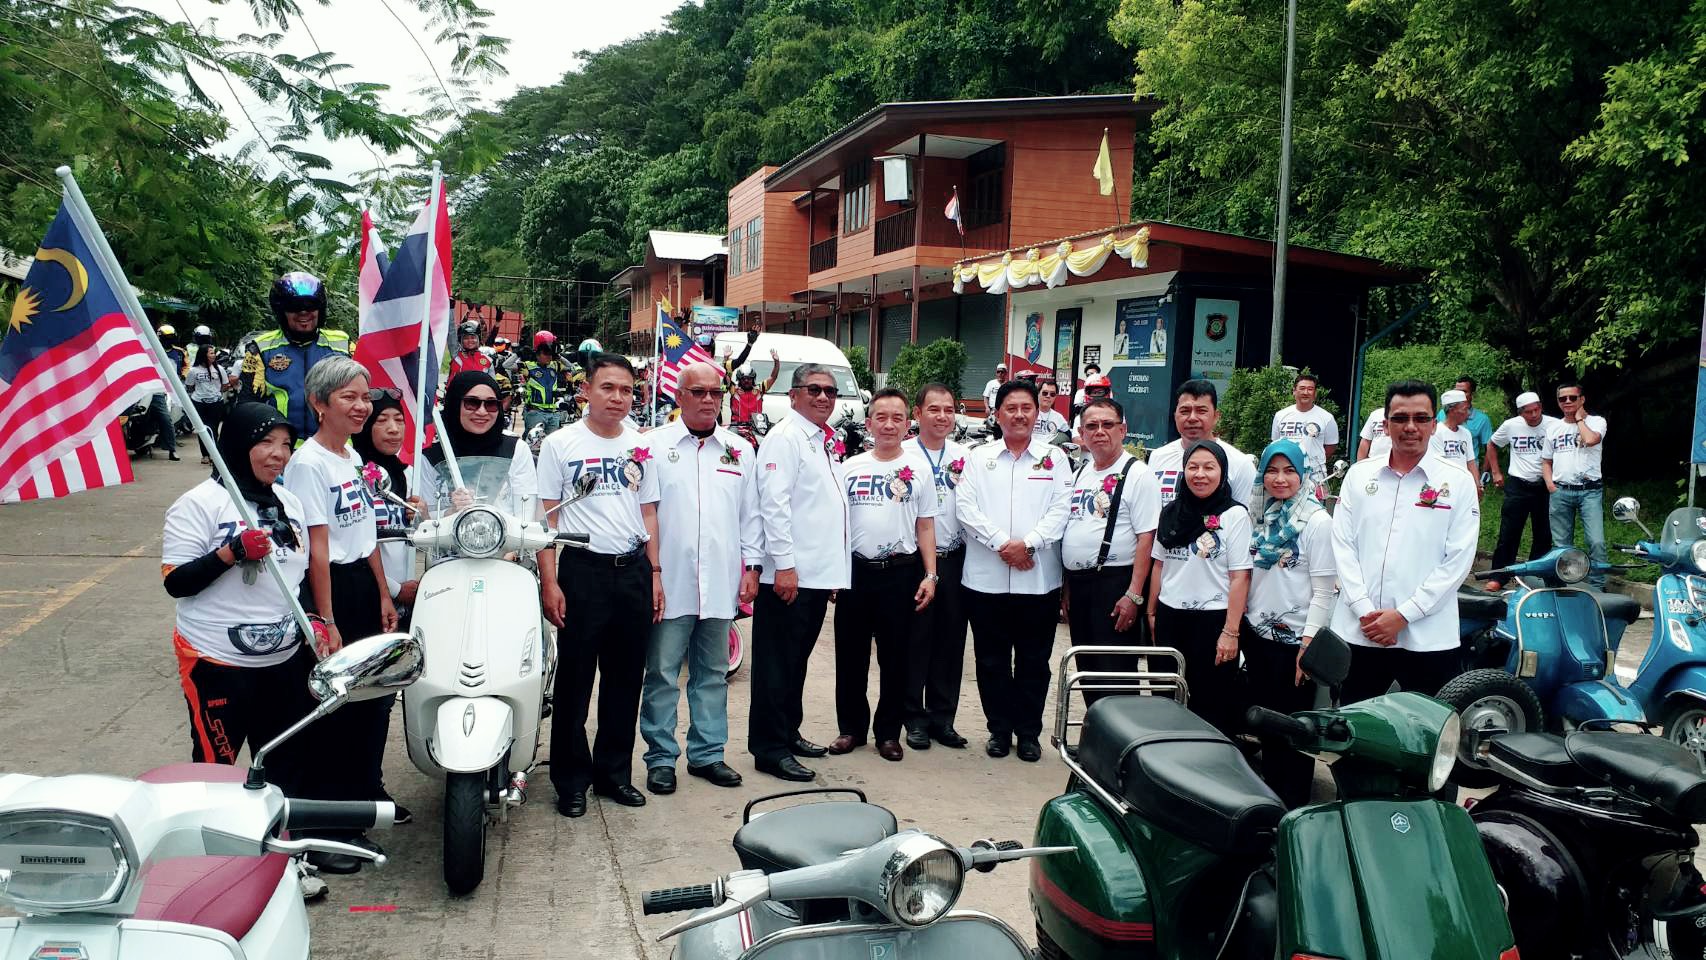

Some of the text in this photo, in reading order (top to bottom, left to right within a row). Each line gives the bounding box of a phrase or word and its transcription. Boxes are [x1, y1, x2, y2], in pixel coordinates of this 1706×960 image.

[1280, 421, 1321, 438] ZERO
[1444, 440, 1468, 456] ZERO
[1512, 435, 1545, 451] ZERO
[568, 457, 645, 488] ZERO
[848, 475, 912, 503] ZERO
[208, 698, 227, 707] SPORT
